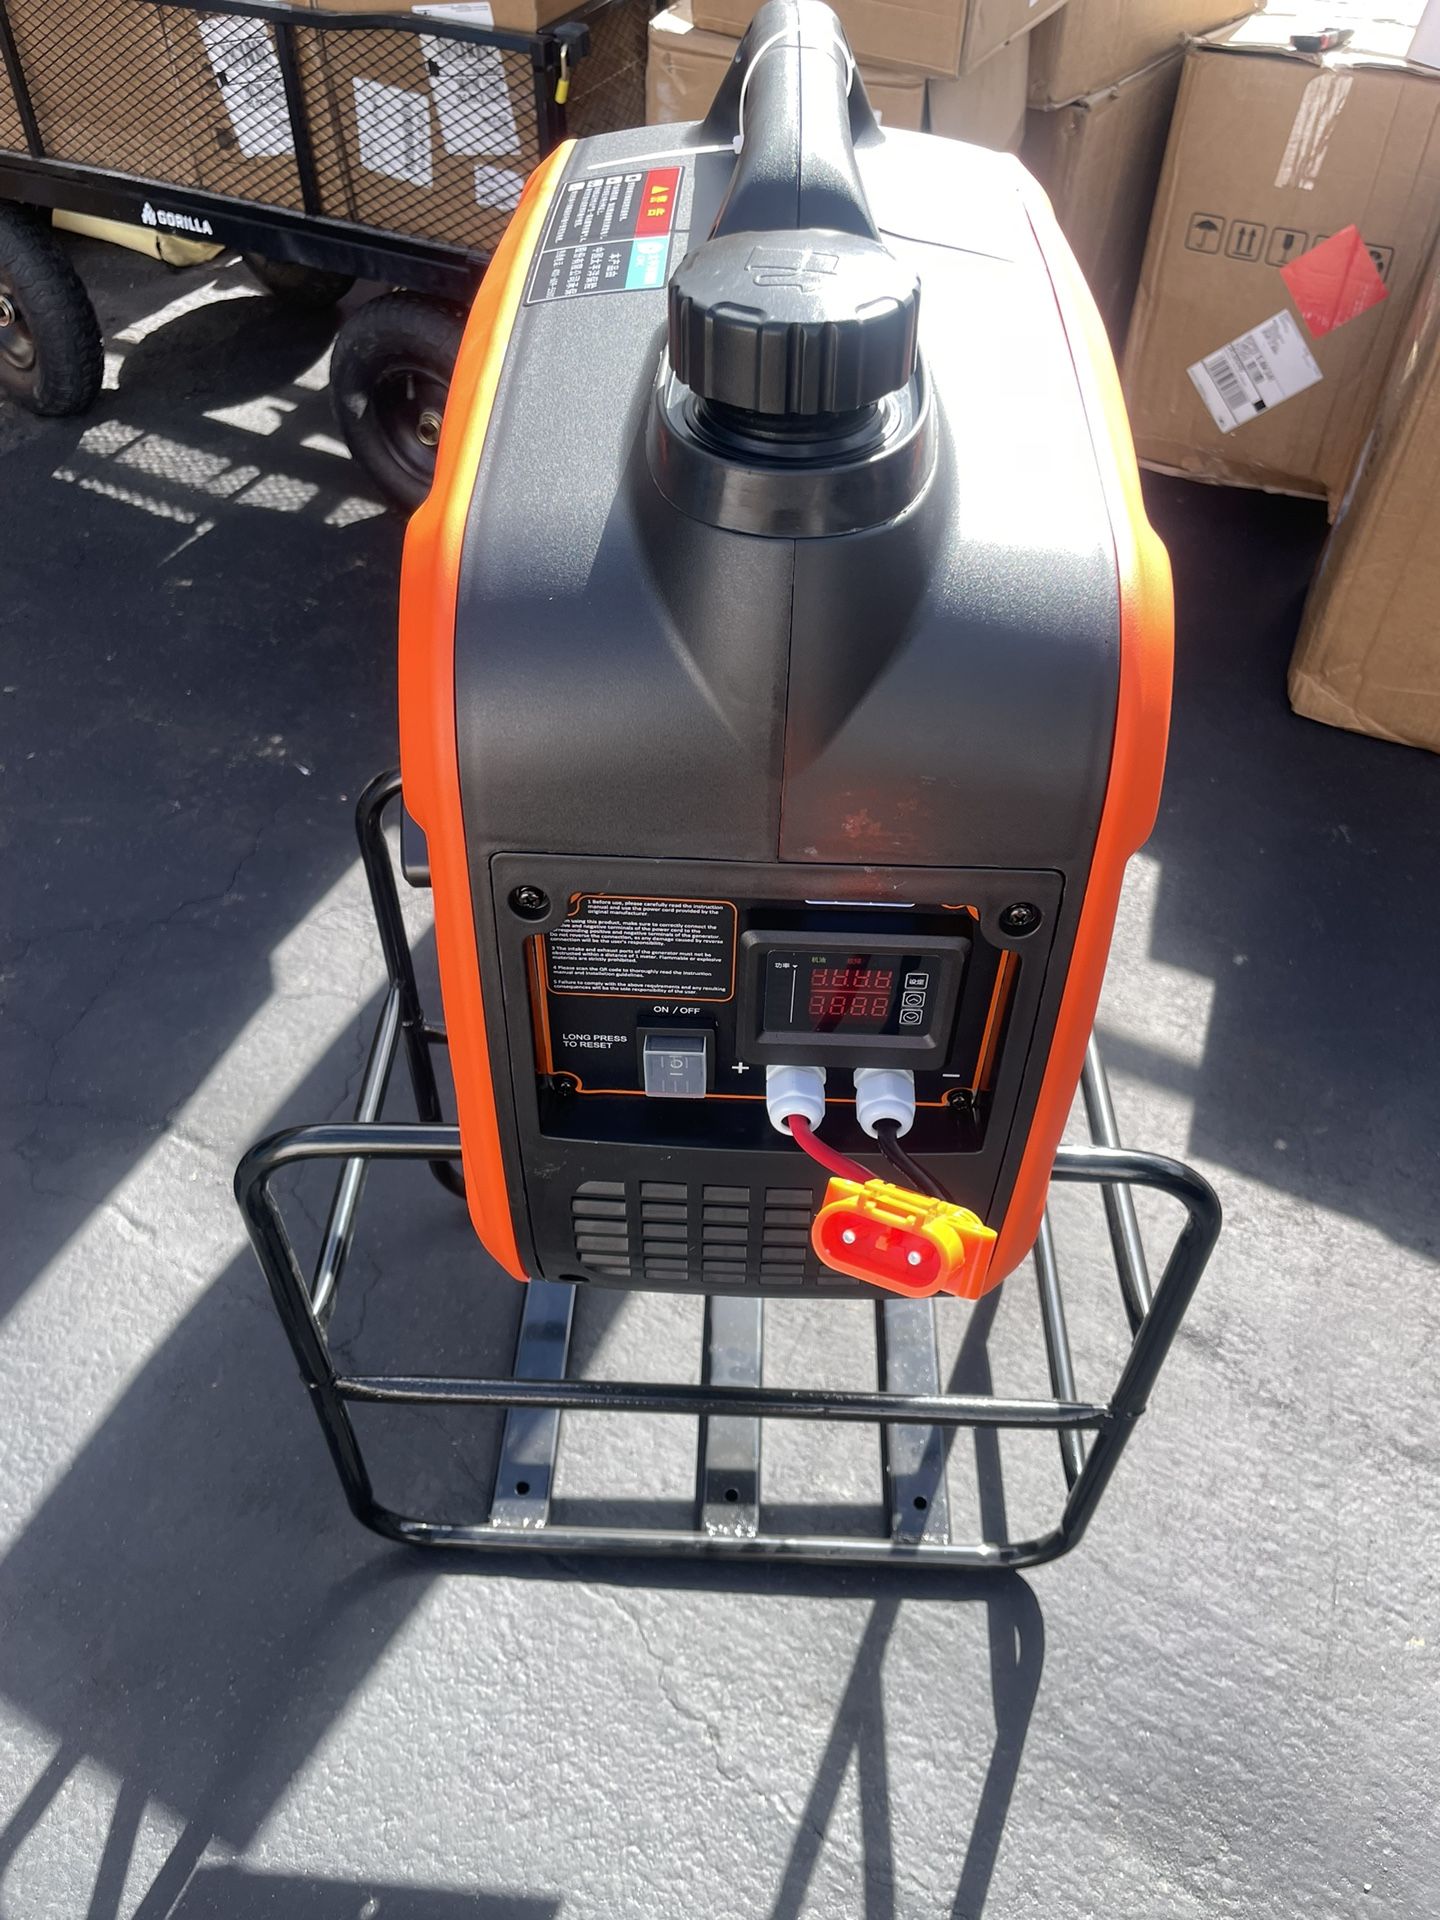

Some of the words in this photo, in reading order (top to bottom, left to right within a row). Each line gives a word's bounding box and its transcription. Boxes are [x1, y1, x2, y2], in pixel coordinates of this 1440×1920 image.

[157, 209, 213, 235] GORILLA
[653, 1005, 669, 1014] ON
[562, 1033, 591, 1042] LONG
[593, 1034, 628, 1043] PRESS
[563, 1040, 578, 1048] TO
[579, 1041, 613, 1049] RESET
